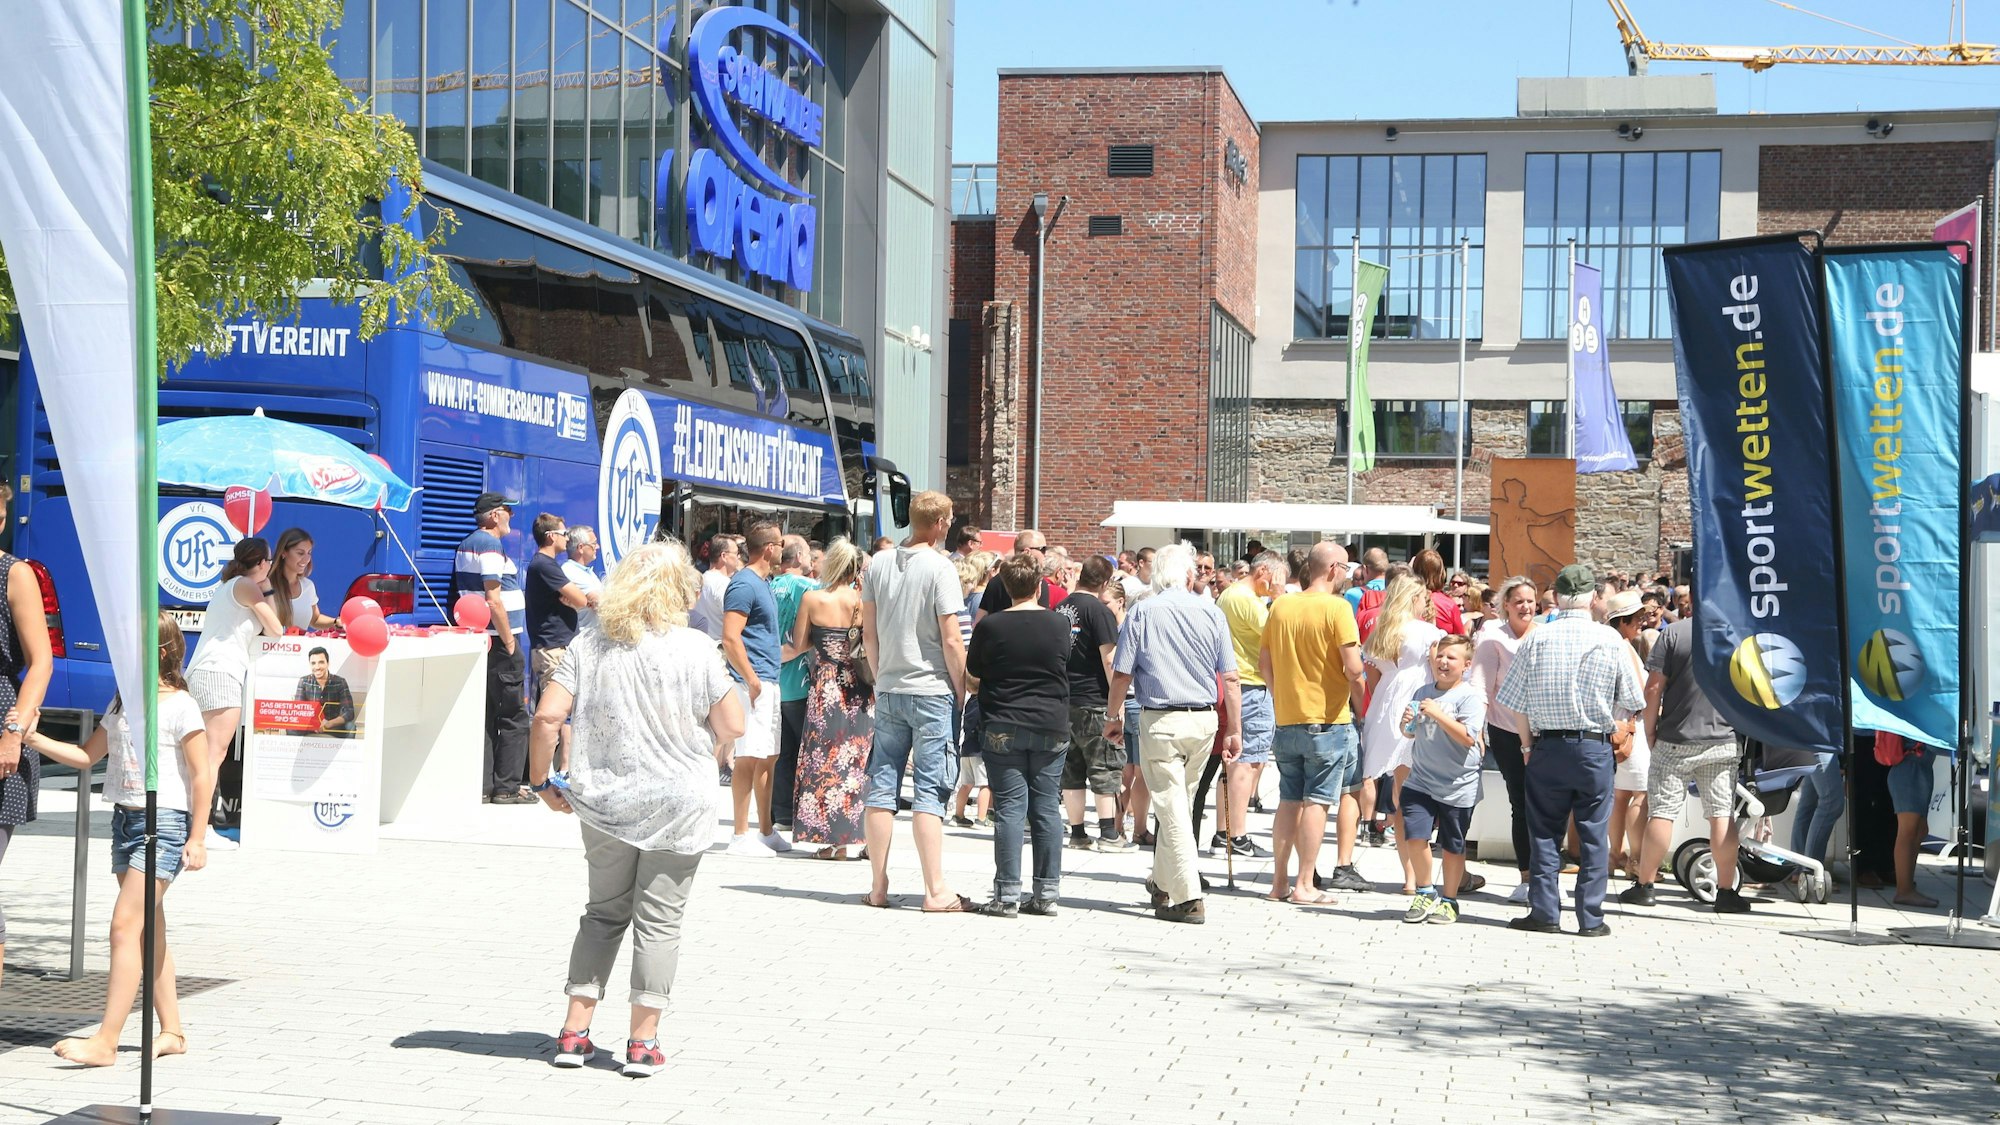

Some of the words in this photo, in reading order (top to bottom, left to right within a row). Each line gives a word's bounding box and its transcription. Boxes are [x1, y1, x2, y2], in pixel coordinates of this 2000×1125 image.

[718, 46, 823, 147] SCHWALBE
[687, 149, 816, 292] arena
[188, 321, 351, 357] FTVEREINT
[427, 371, 555, 428] WWW.VFL-GUMMERSBACH.DE
[571, 400, 586, 421] DKB
[1721, 274, 1788, 619] sportwetten.de
[1866, 282, 1911, 615] sportwetten.de
[189, 503, 206, 513] VfL
[226, 489, 247, 502] DKMS
[163, 577, 214, 600] GUMMERSB
[262, 643, 293, 653] DKMS
[293, 703, 315, 711] MITTEL
